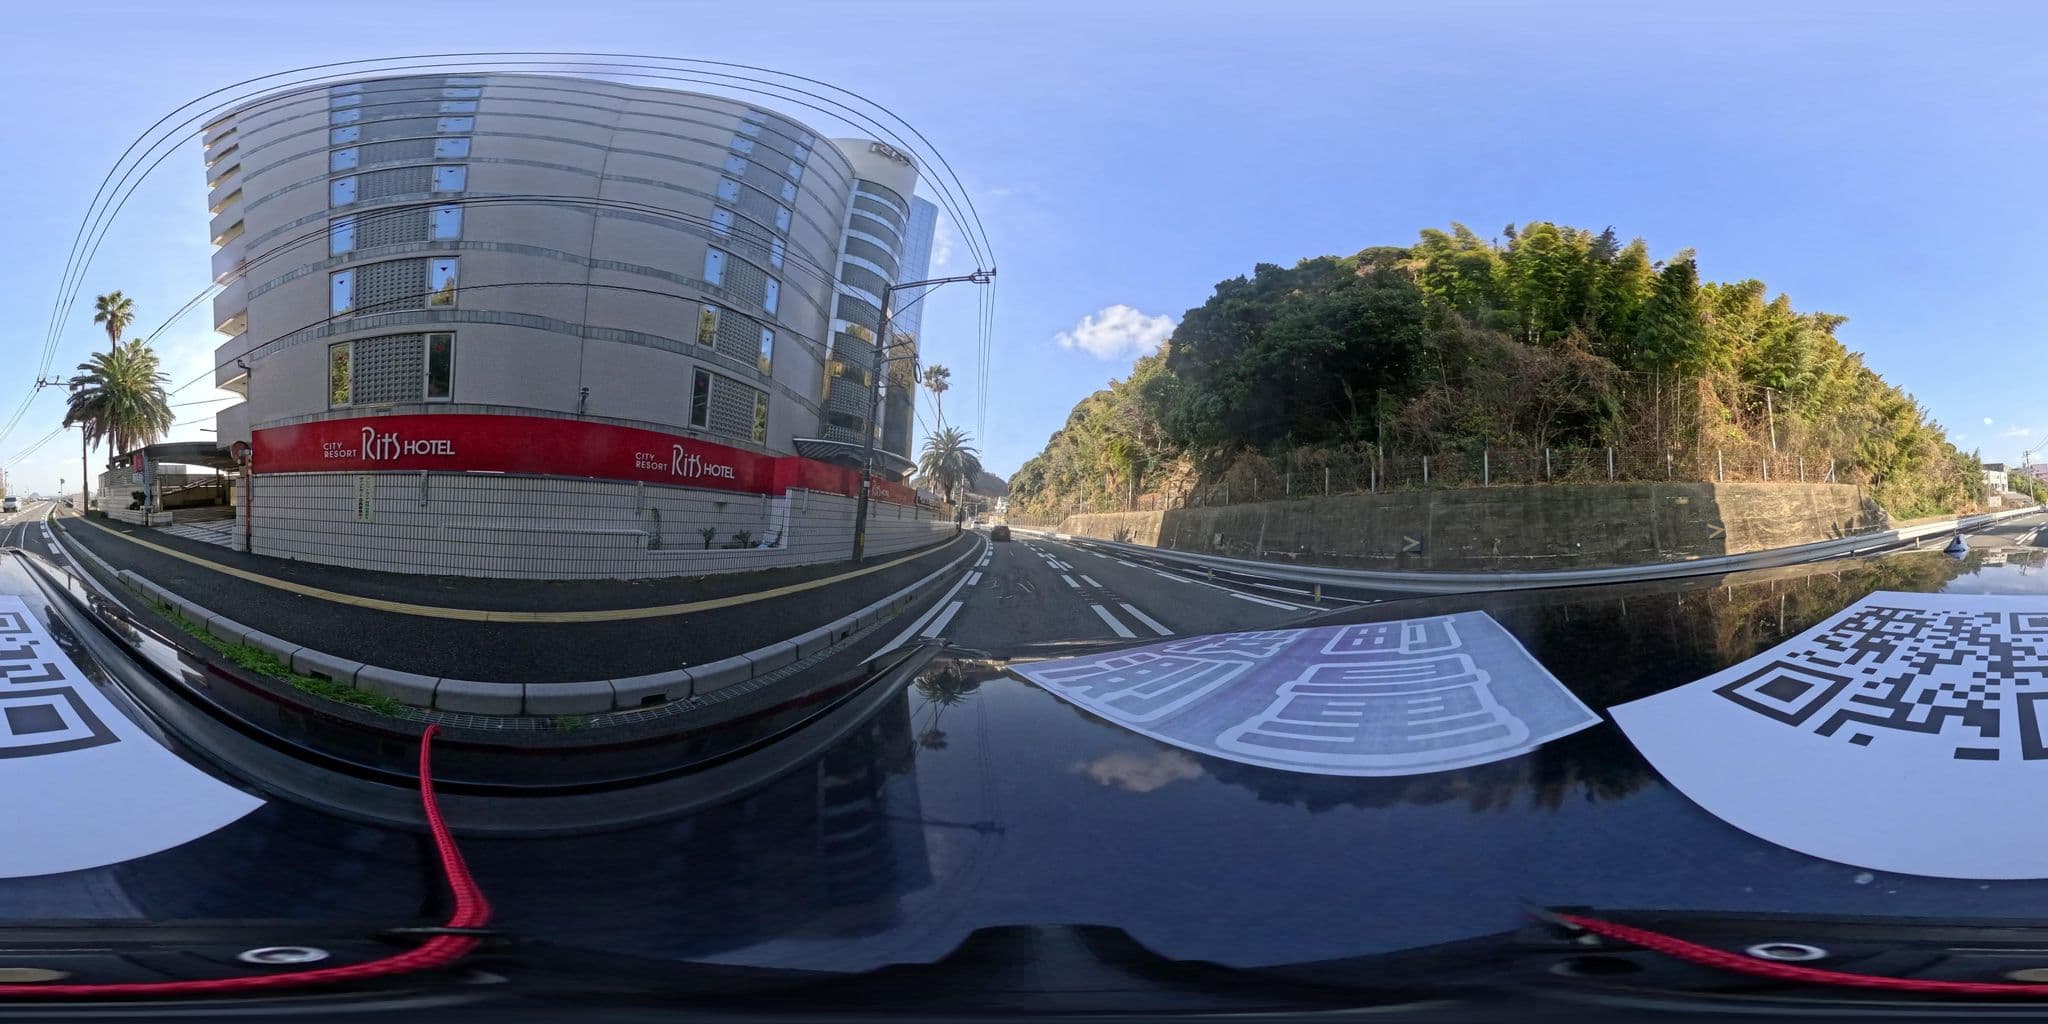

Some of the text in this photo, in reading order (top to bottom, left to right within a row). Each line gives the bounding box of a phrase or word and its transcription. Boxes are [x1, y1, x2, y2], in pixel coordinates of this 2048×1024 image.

[323, 442, 343, 451] CITY
[403, 440, 456, 455] HOTEL
[324, 449, 357, 458] RESORT
[635, 452, 656, 461] CITY
[635, 460, 668, 472] RESORT
[703, 463, 735, 479] HOTEL
[1027, 653, 1529, 767] 測量
